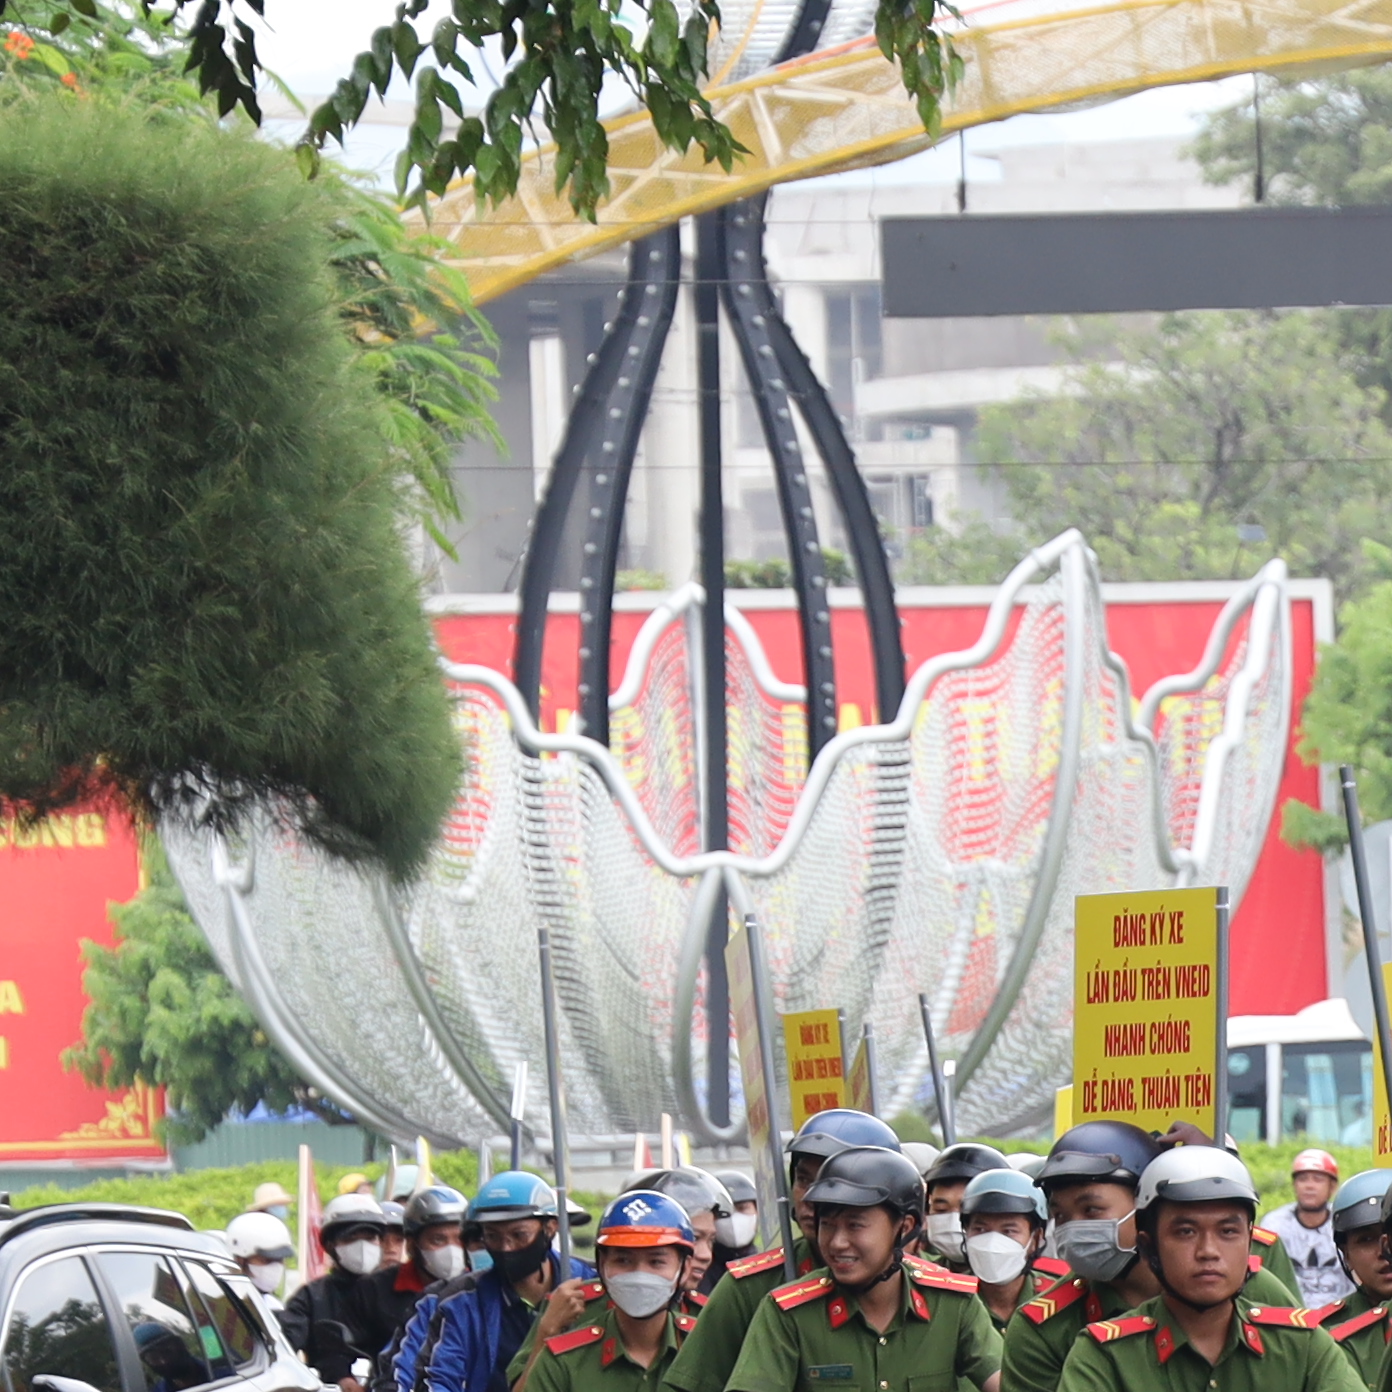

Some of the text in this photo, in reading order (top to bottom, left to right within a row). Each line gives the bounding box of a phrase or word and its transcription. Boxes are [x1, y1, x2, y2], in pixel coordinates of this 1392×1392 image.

[1113, 905, 1184, 948] ĐĂNG KÝ XE
[1086, 957, 1210, 1004] LẦN ĐẦU TRÊN VNEID
[1104, 1013, 1190, 1058] NHANH CHÓNG
[1083, 1066, 1211, 1117] DỄ DÀNG, THUẬN TIỆN
